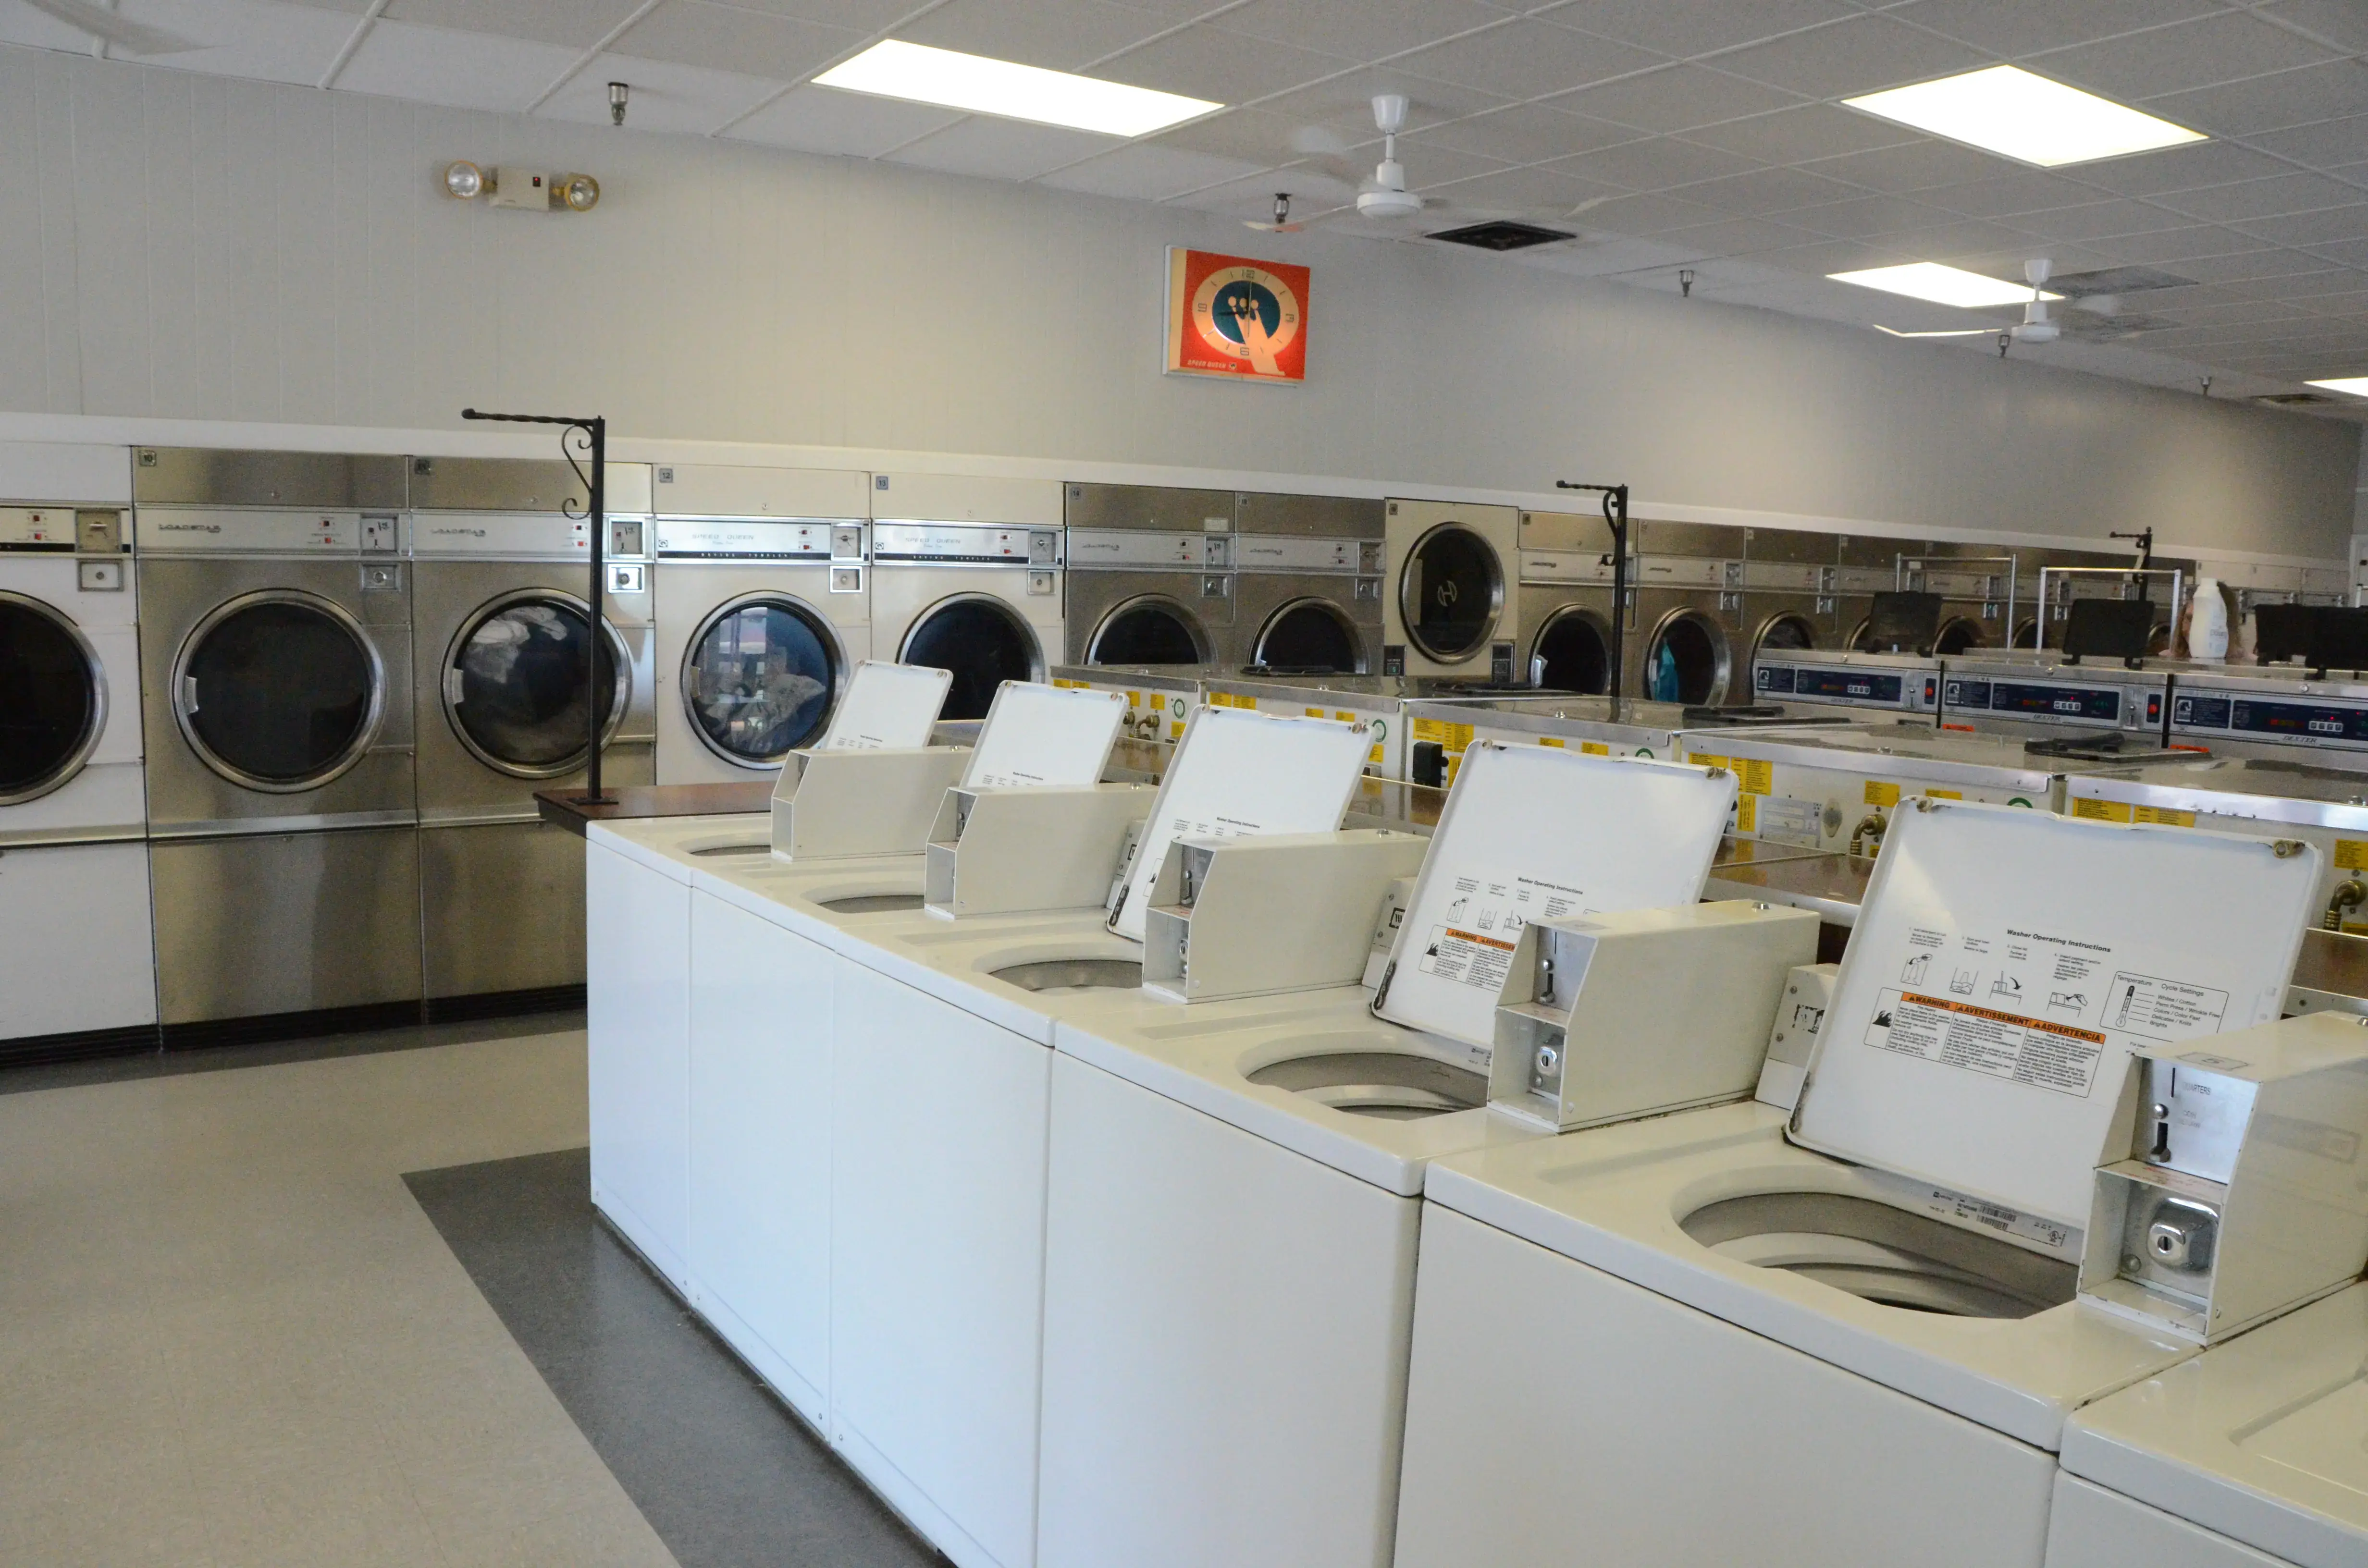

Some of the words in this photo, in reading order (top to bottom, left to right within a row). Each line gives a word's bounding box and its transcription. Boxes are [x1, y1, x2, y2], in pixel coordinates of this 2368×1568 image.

[2282, 735, 2317, 744] DEXTER
[1534, 880, 1555, 890] Operating
[1556, 885, 1583, 895] Instructions
[2007, 929, 2031, 938] Washer
[2033, 933, 2067, 945] Operating
[2068, 940, 2111, 953] Instructions
[2117, 974, 2152, 986] Temperature
[2161, 983, 2178, 992] Cycle
[2179, 986, 2204, 997] Settings
[1916, 997, 1950, 1009] WARNING
[2158, 994, 2174, 1003] Whites
[1964, 1006, 2029, 1026] AVERTISSEMENT
[2149, 1020, 2167, 1028] Brights
[2041, 1023, 2100, 1042] ADVERTENCIA
